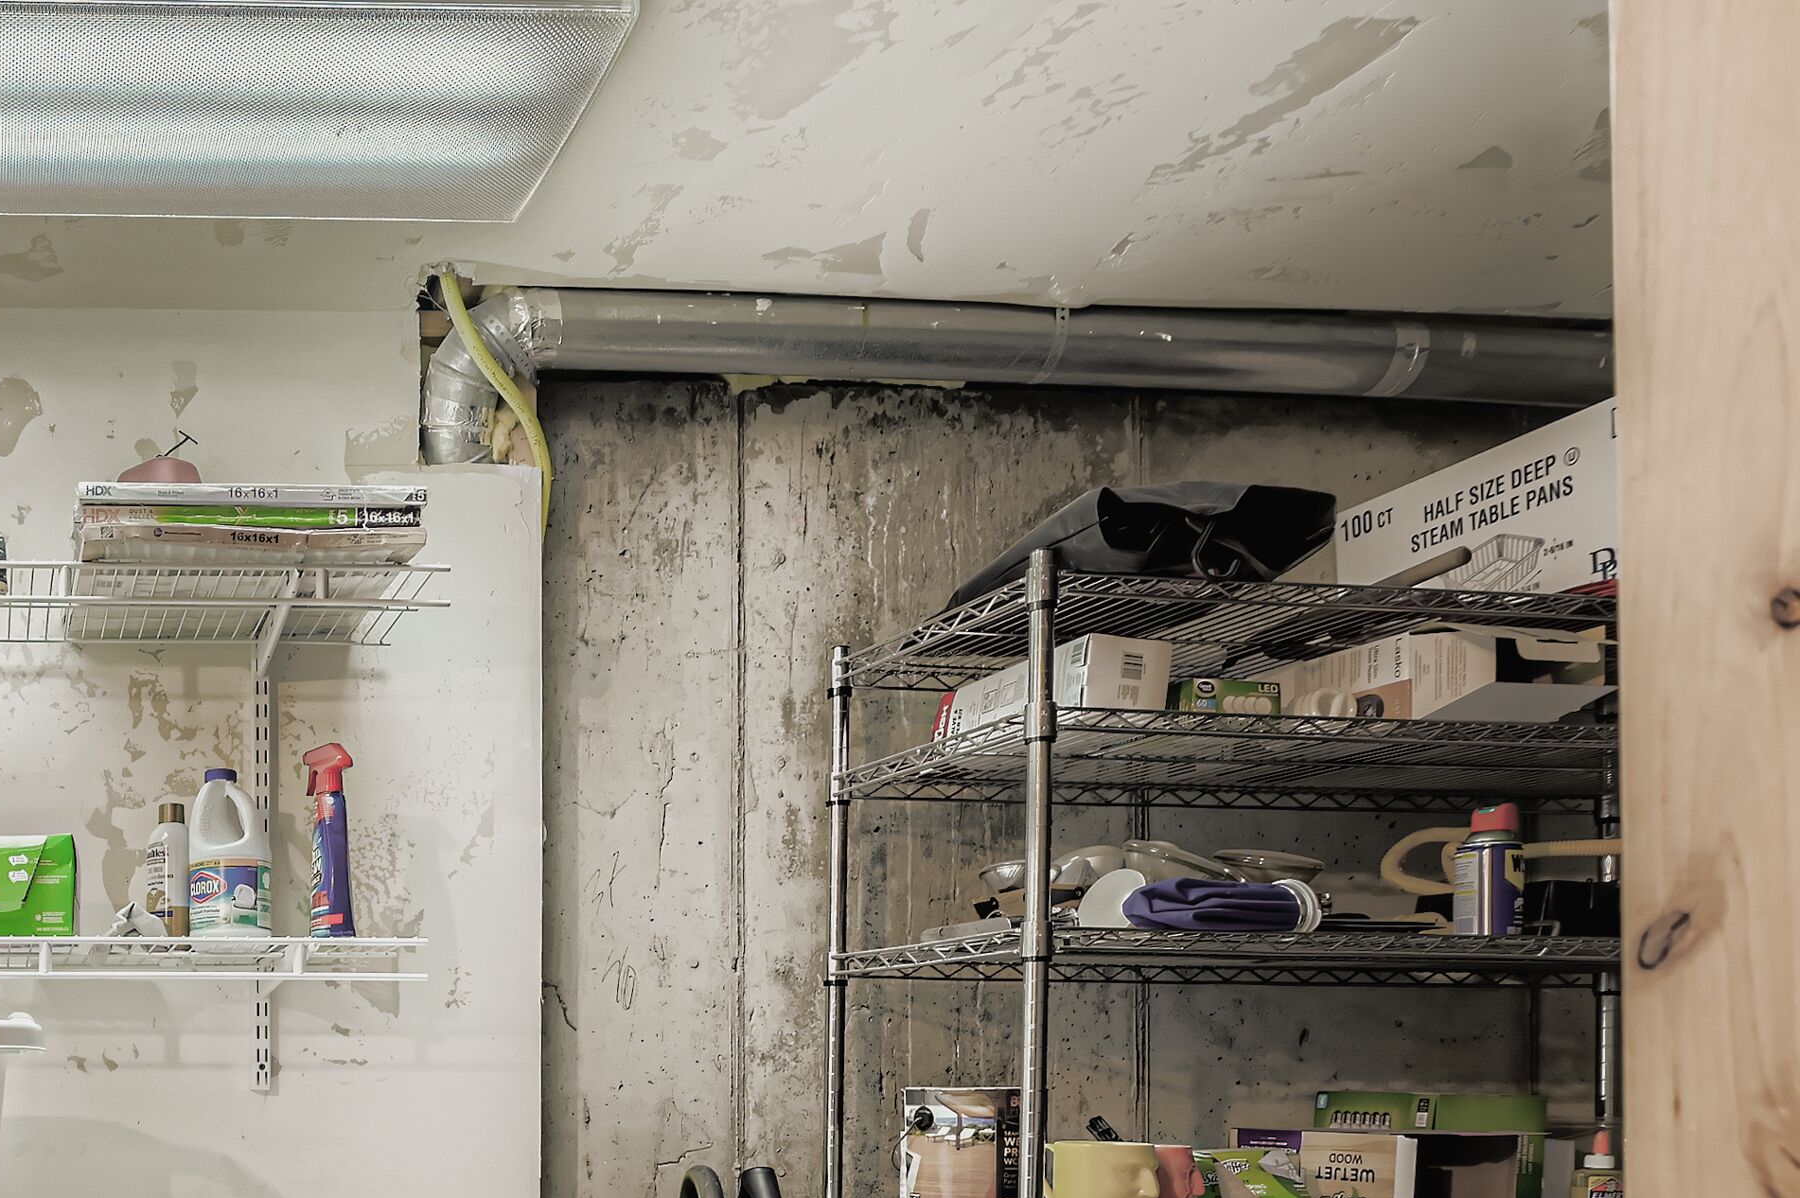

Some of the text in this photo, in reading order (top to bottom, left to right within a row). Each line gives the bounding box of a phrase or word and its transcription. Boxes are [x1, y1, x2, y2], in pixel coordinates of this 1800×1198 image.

[85, 485, 112, 497] HDX
[1423, 454, 1557, 524] HALF SIZE DEEP
[83, 507, 121, 524] HDX
[336, 509, 348, 525] 5
[1410, 475, 1574, 553] STEAM TABLE PANS
[1340, 507, 1394, 543] 100 CT
[230, 532, 279, 543] 16x16x1
[1394, 637, 1403, 679] Lasko
[1258, 684, 1279, 693] LED
[191, 880, 219, 897] CLOROX
[1329, 1153, 1363, 1165] WOOD
[1315, 1165, 1375, 1183] WETJET
